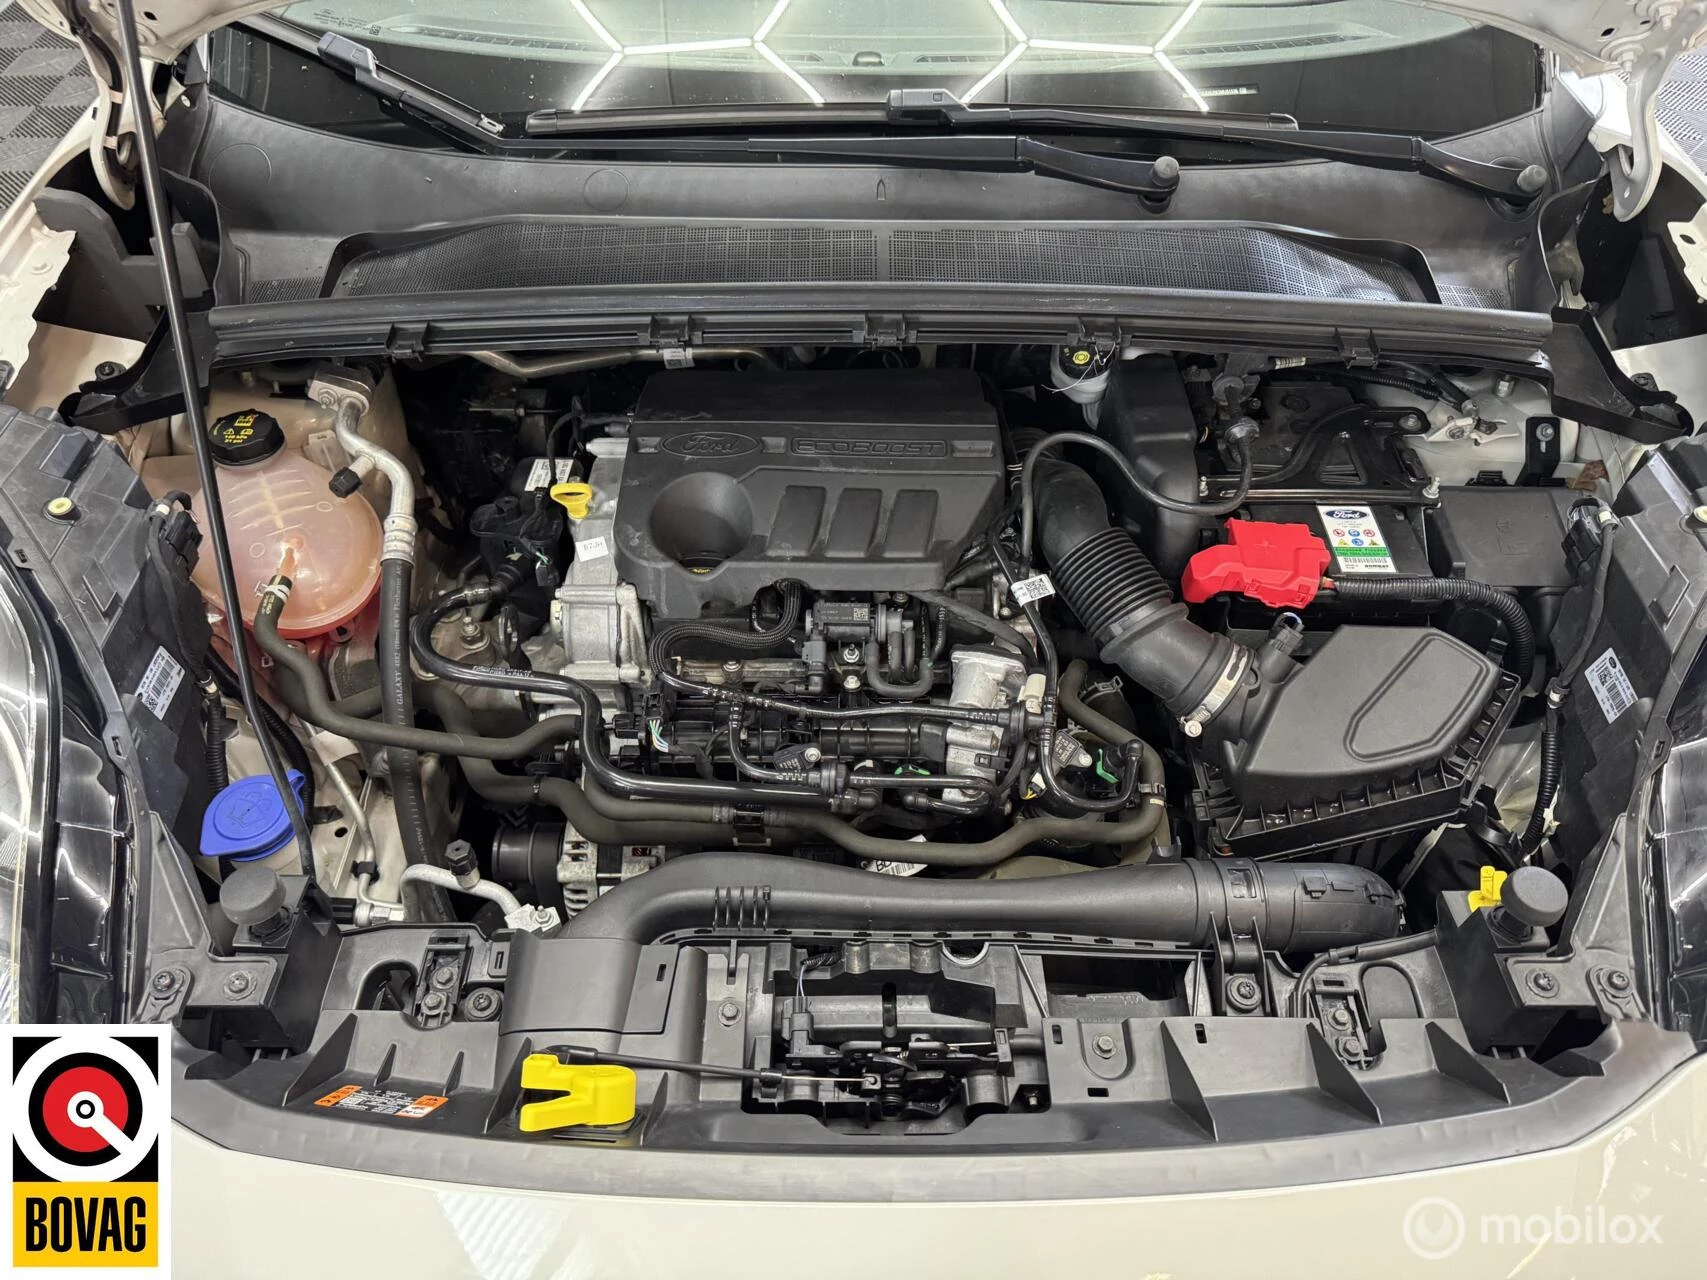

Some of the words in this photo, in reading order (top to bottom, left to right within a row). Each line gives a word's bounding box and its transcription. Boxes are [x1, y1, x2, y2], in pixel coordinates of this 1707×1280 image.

[681, 434, 740, 453] Ford
[795, 440, 942, 455] ECOBOOST
[394, 669, 404, 705] GALAXY
